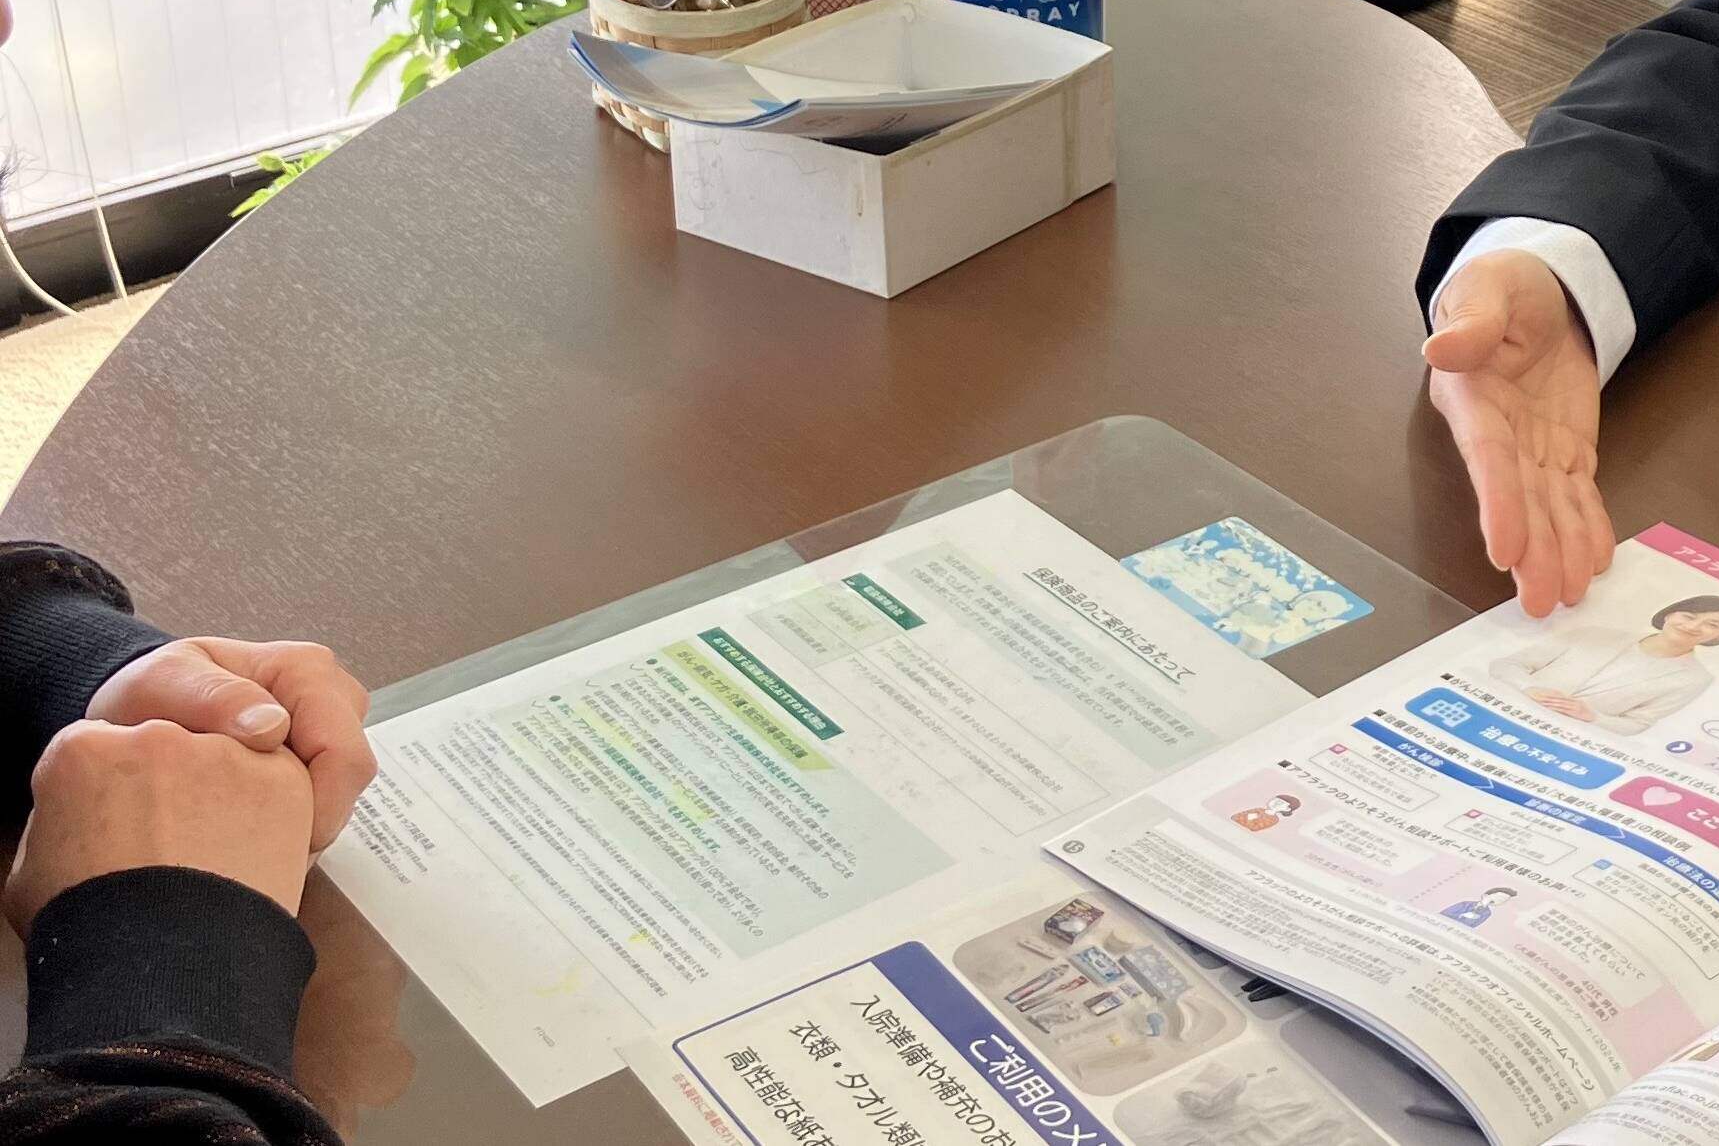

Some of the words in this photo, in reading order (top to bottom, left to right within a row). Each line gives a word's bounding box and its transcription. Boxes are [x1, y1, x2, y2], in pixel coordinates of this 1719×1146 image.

[988, 1, 1080, 23] RAY
[789, 1019, 927, 1146] 衣類・タオル類
